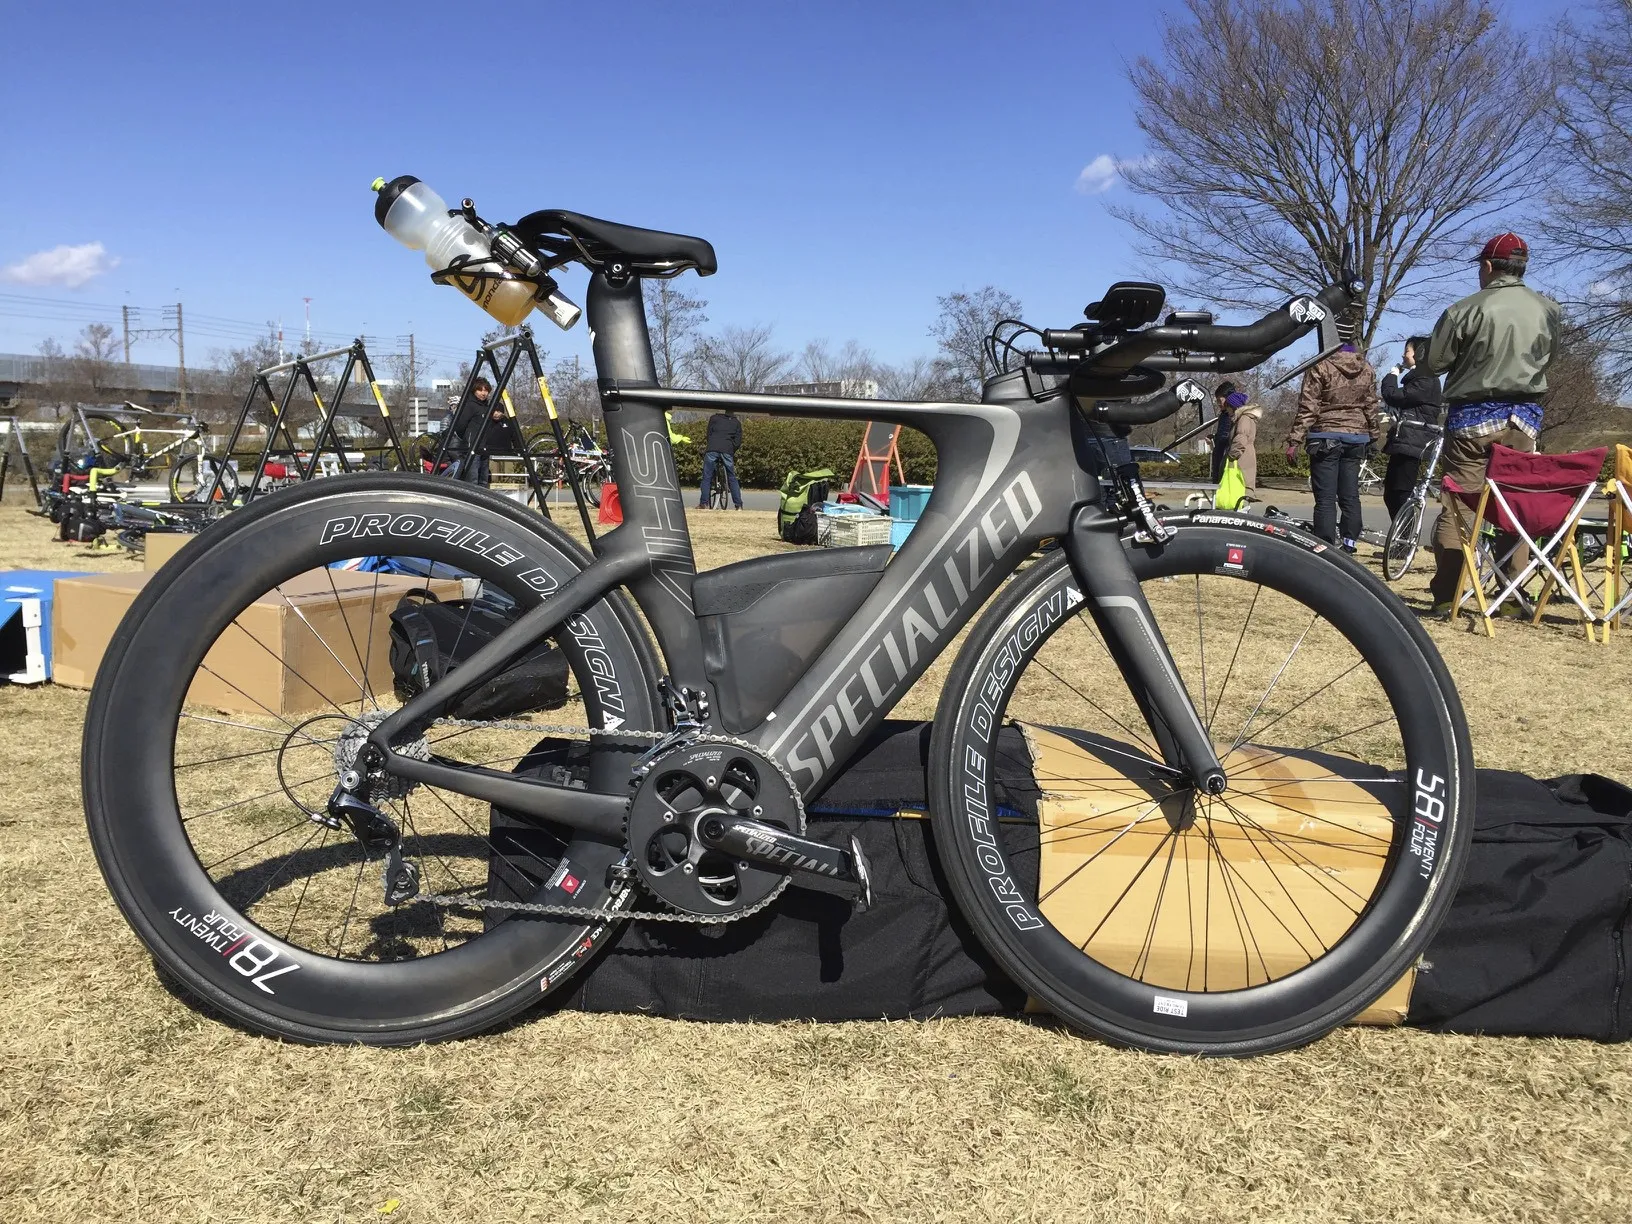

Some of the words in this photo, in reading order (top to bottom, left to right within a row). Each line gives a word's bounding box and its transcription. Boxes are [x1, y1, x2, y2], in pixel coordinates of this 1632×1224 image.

[1192, 514, 1246, 527] Panaracer
[320, 513, 525, 567] PROFILE
[517, 567, 625, 713] DSIGN
[786, 470, 1043, 800] SPECIALIZED
[971, 589, 1062, 743] DESIGN
[1415, 768, 1446, 823] 58
[732, 824, 778, 844] SPECIALIZED
[965, 745, 1044, 931] PROFILE
[1410, 821, 1426, 856] FOUR
[1420, 828, 1438, 880] TWENTY
[168, 907, 229, 954] TWENTY
[203, 909, 246, 942] FOUR
[228, 939, 301, 995] 78
